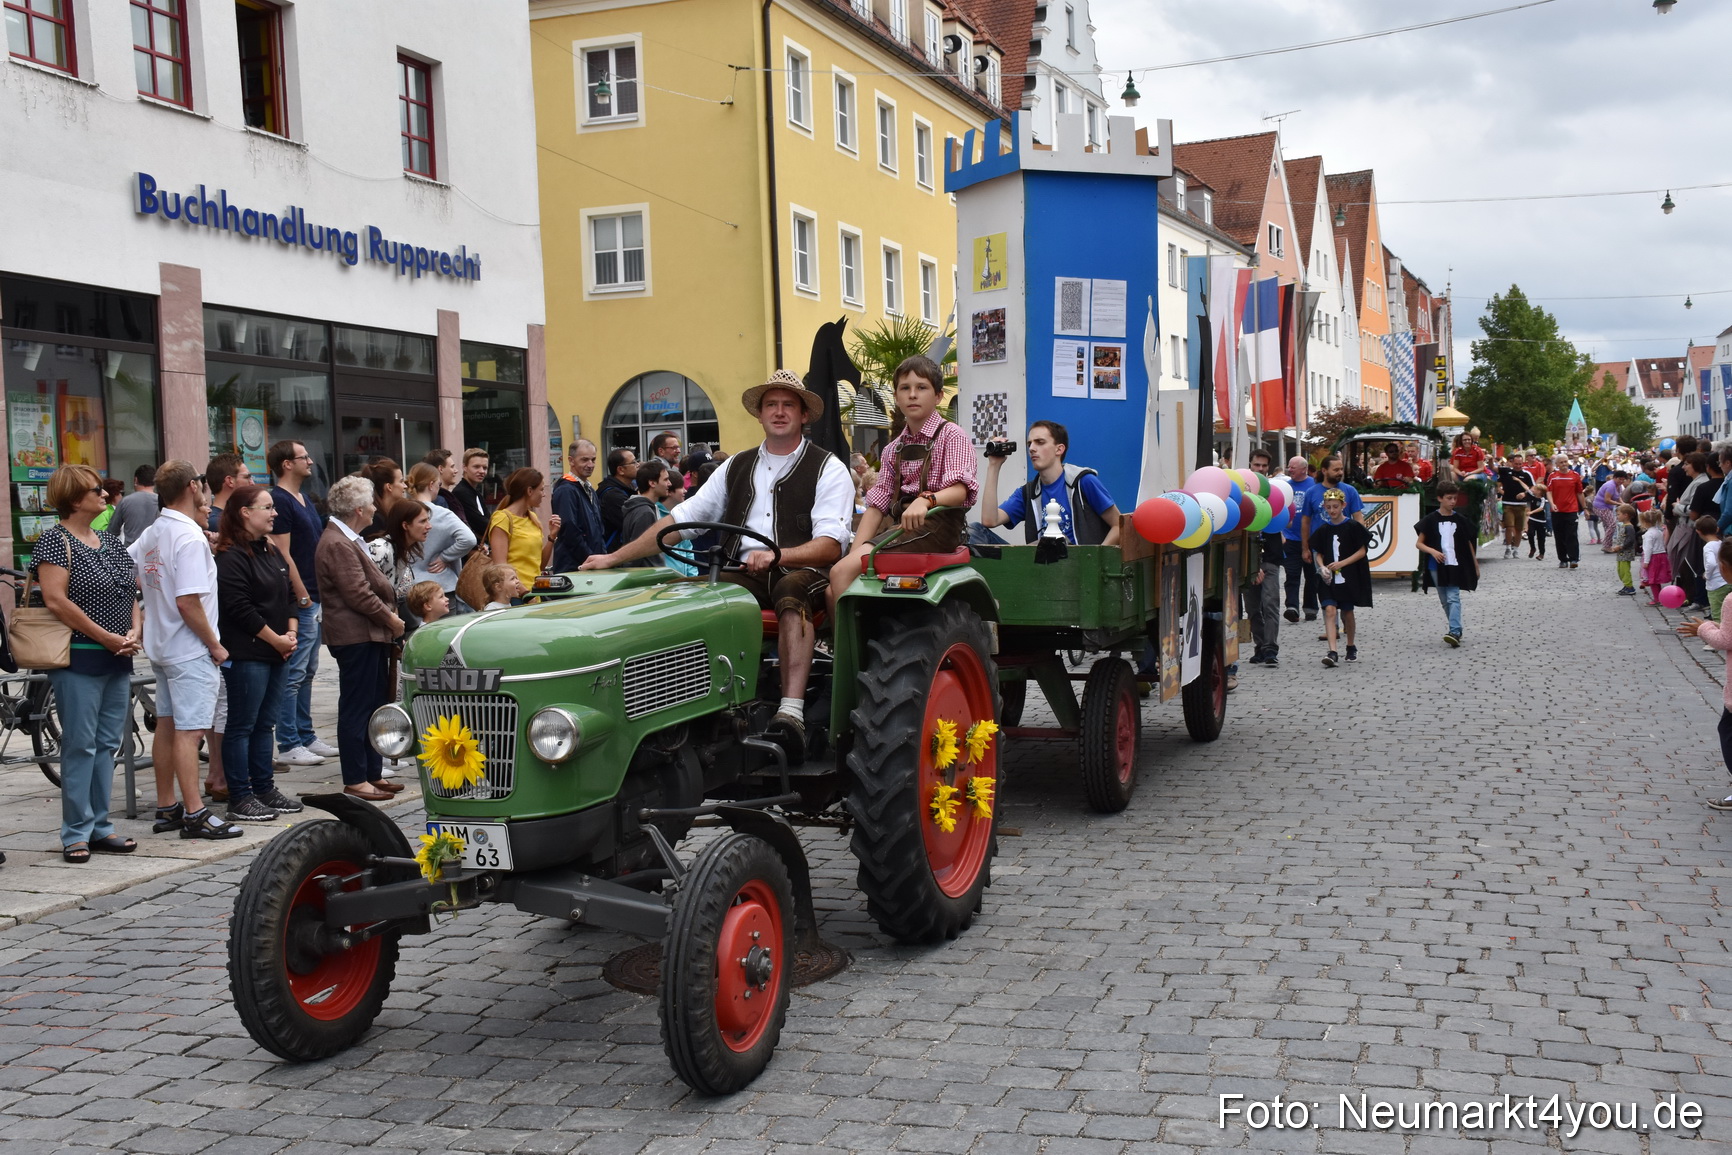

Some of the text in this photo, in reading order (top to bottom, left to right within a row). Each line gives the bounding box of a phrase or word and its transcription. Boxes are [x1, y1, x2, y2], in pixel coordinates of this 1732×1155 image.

[134, 172, 482, 281] Buchhandlung Rupprecht
[1435, 356, 1446, 406] HOTE
[464, 411, 510, 421] mpfehlungen
[415, 669, 500, 690] FENDT
[476, 848, 500, 867] 63
